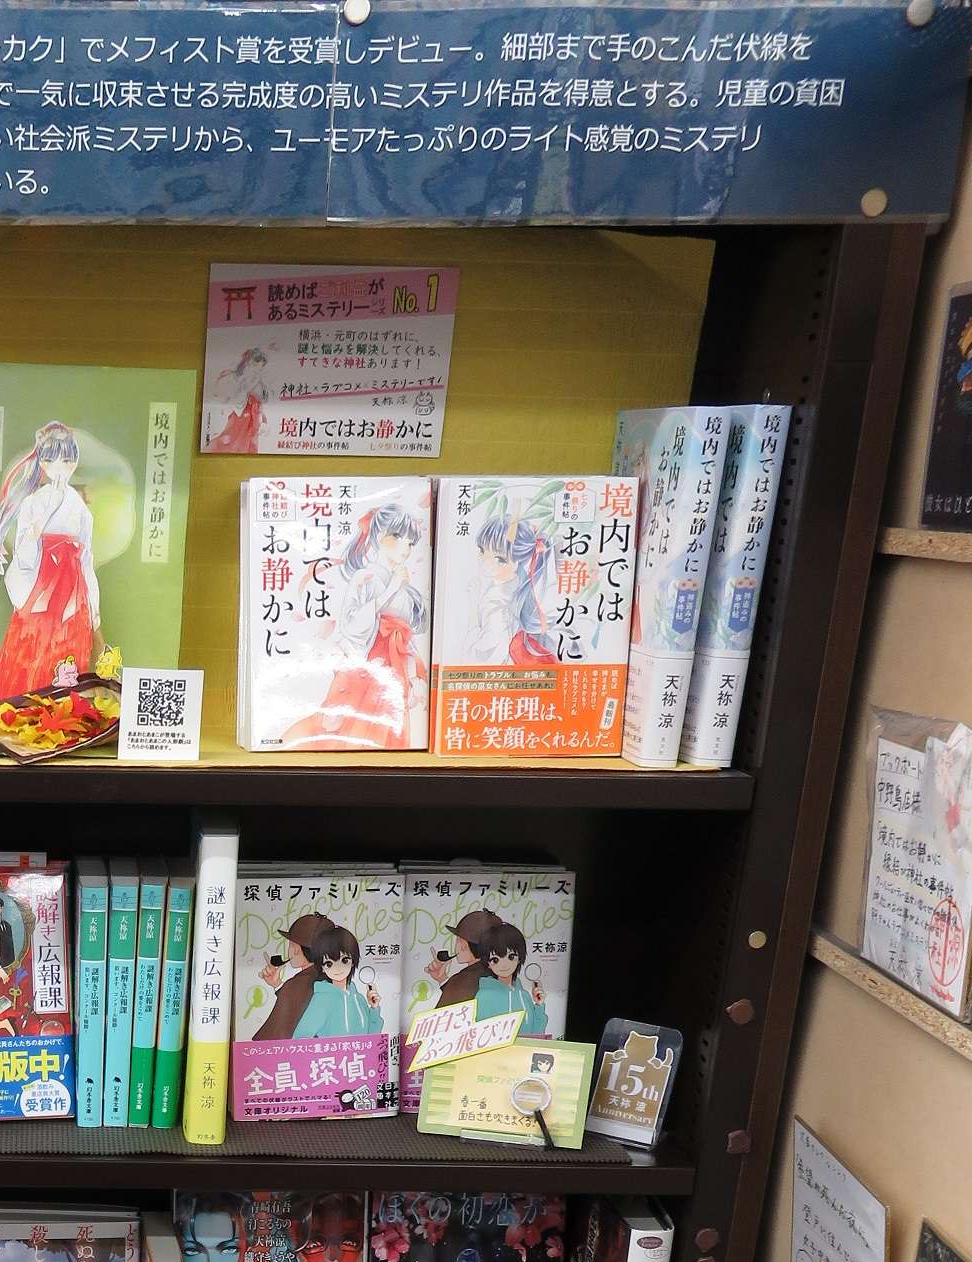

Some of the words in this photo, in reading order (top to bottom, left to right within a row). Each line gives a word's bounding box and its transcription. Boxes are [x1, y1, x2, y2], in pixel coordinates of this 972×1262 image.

[279, 417, 432, 439] 境内ではお静かに
[147, 412, 170, 558] 境内ではお静かに
[740, 415, 782, 573] 境内ではお静かに
[338, 484, 352, 535] 天祢涼
[597, 483, 634, 622] 境内では
[261, 525, 294, 657] お静かに
[557, 527, 593, 662] お静かに
[447, 696, 563, 723] 君の推理は、
[445, 727, 615, 751] 皆に笑顔をくれるんだ。
[244, 881, 403, 902] 探偵ファミリーズ
[413, 879, 572, 898] 探偵ファミリーズ
[201, 885, 227, 1026] 謎解き広報課
[365, 943, 400, 957] 天祢涼
[532, 942, 568, 954] 天祢涼
[243, 1054, 377, 1097] 全員、探偵。
[604, 1062, 660, 1101] 15th
[25, 1096, 67, 1112] 受賞作
[244, 1105, 309, 1116] 文庫オリジナル
[378, 1193, 548, 1226] ぼくの初恋が
